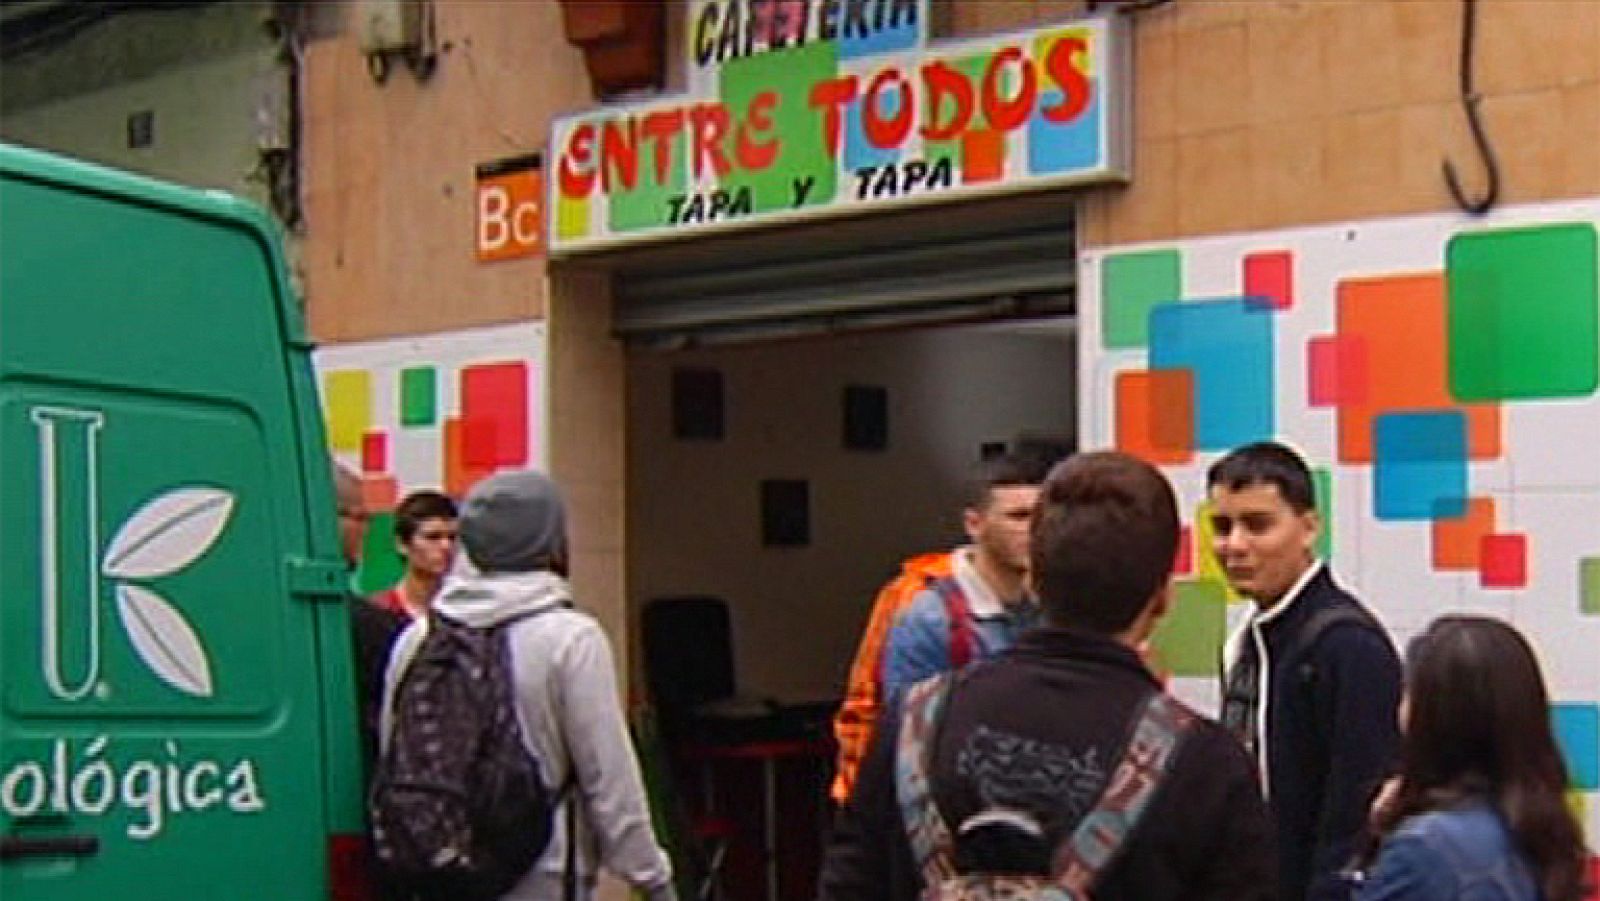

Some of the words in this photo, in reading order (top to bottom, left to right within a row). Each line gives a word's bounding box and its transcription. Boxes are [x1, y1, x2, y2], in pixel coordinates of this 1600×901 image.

[560, 91, 780, 199] ENTRE
[809, 38, 1091, 157] TODOS
[479, 187, 539, 250] Bc
[667, 186, 753, 224] TAPA
[855, 157, 953, 199] TAPA
[0, 736, 265, 838] ológica
